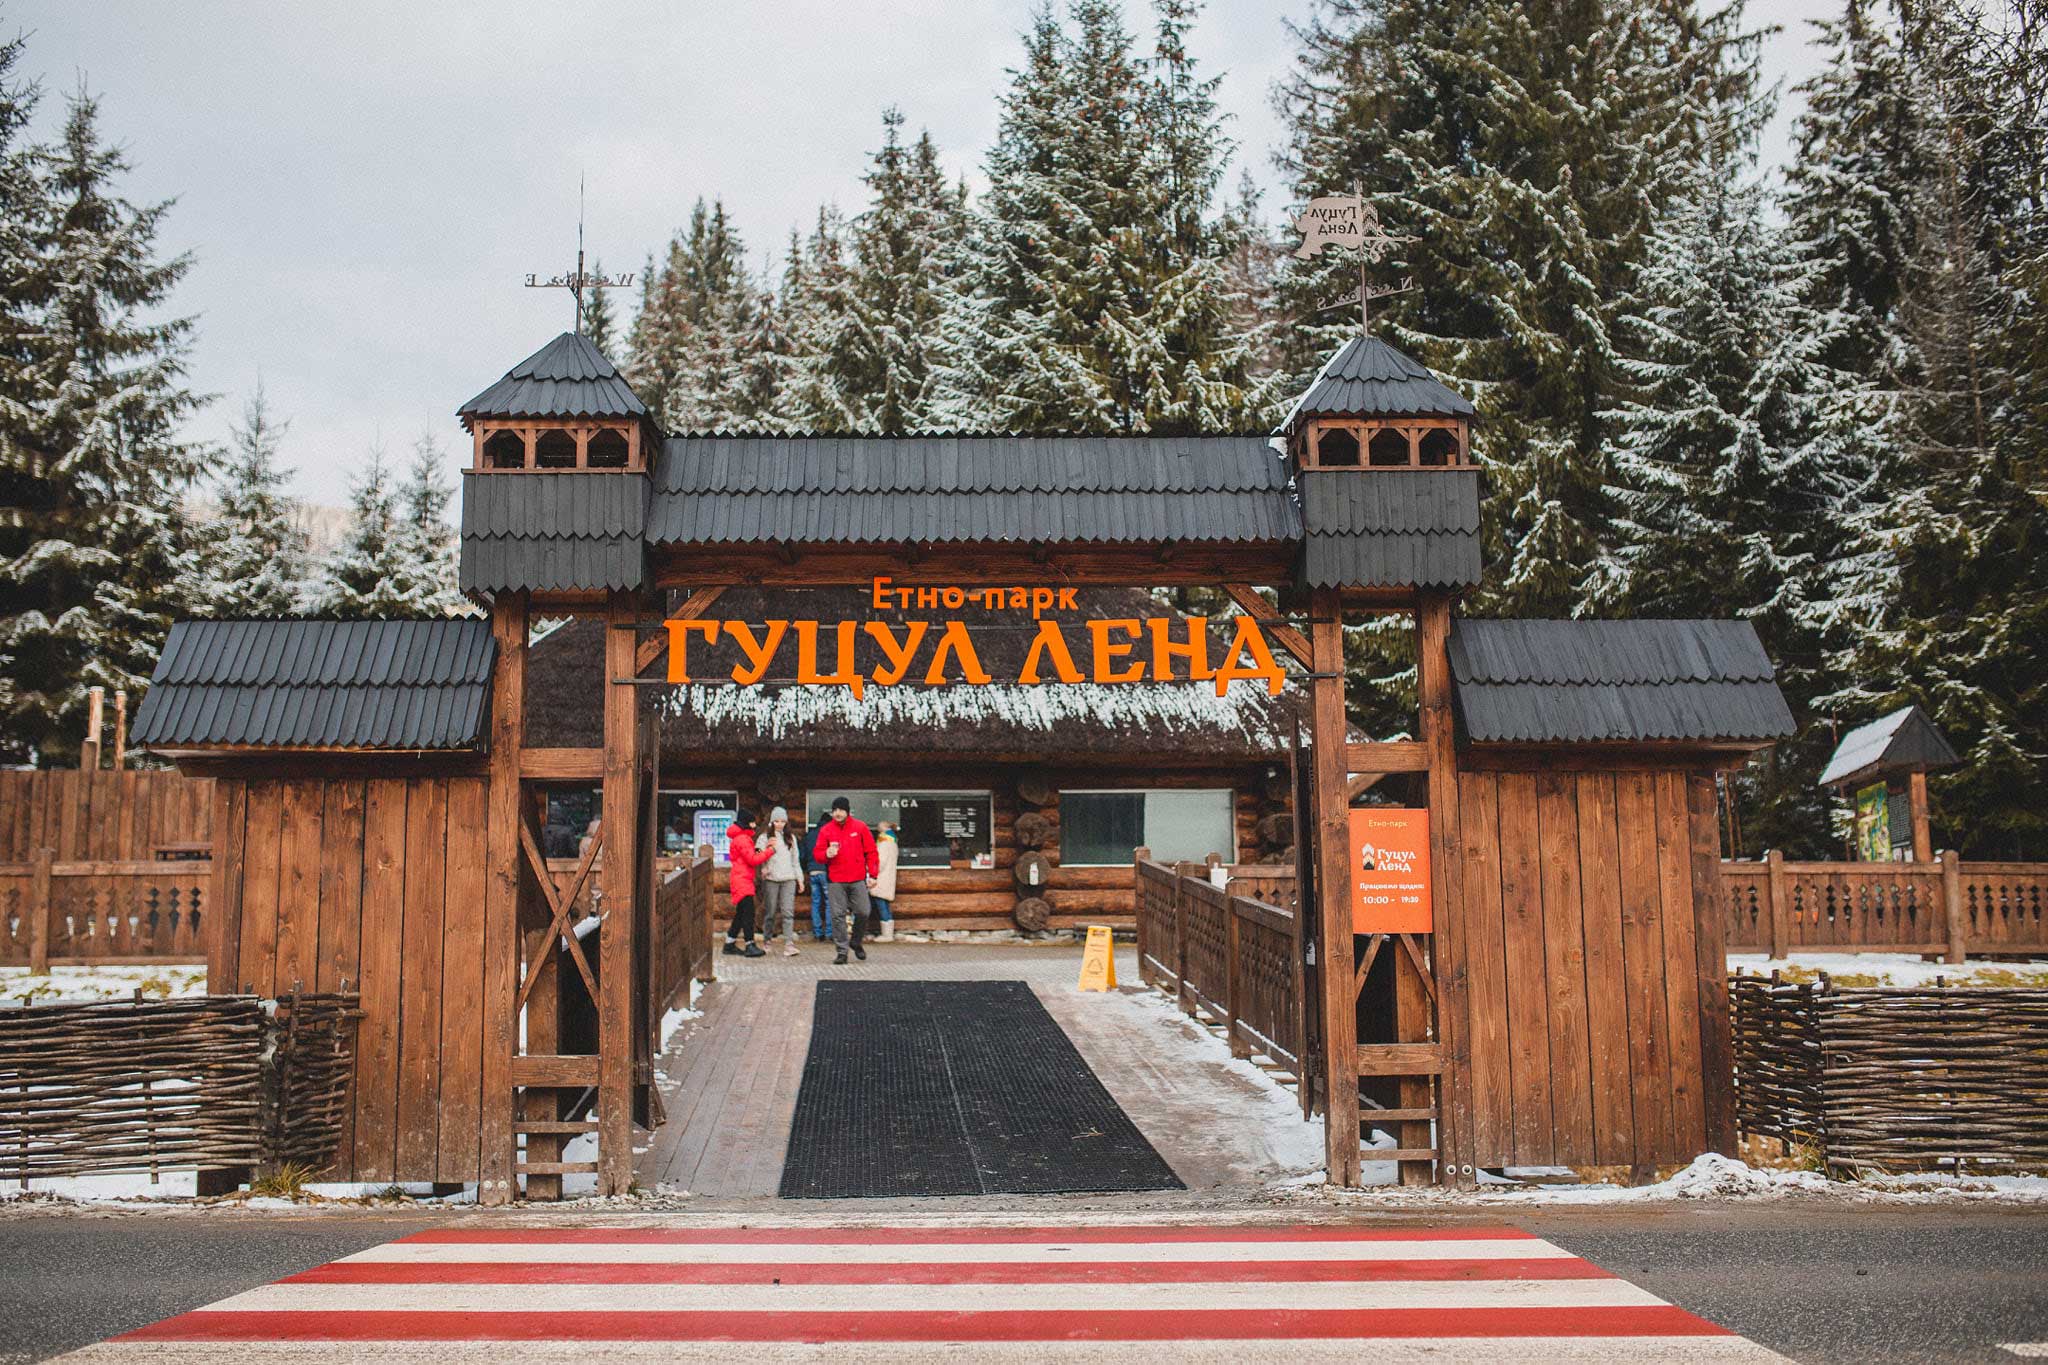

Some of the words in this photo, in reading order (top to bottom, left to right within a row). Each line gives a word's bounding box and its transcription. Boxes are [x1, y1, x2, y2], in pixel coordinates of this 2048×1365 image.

[873, 577, 1079, 620] Етно-парк
[663, 619, 993, 701] ГУЦУЛ
[1019, 616, 1287, 697] ЛЕНД
[678, 799, 704, 807] ФАСТ
[881, 799, 919, 808] КАСА
[1368, 819, 1408, 828] Етно-парк
[1377, 849, 1416, 862] Гуцул
[1378, 861, 1411, 872] Ленд
[1363, 896, 1389, 904] 10:00
